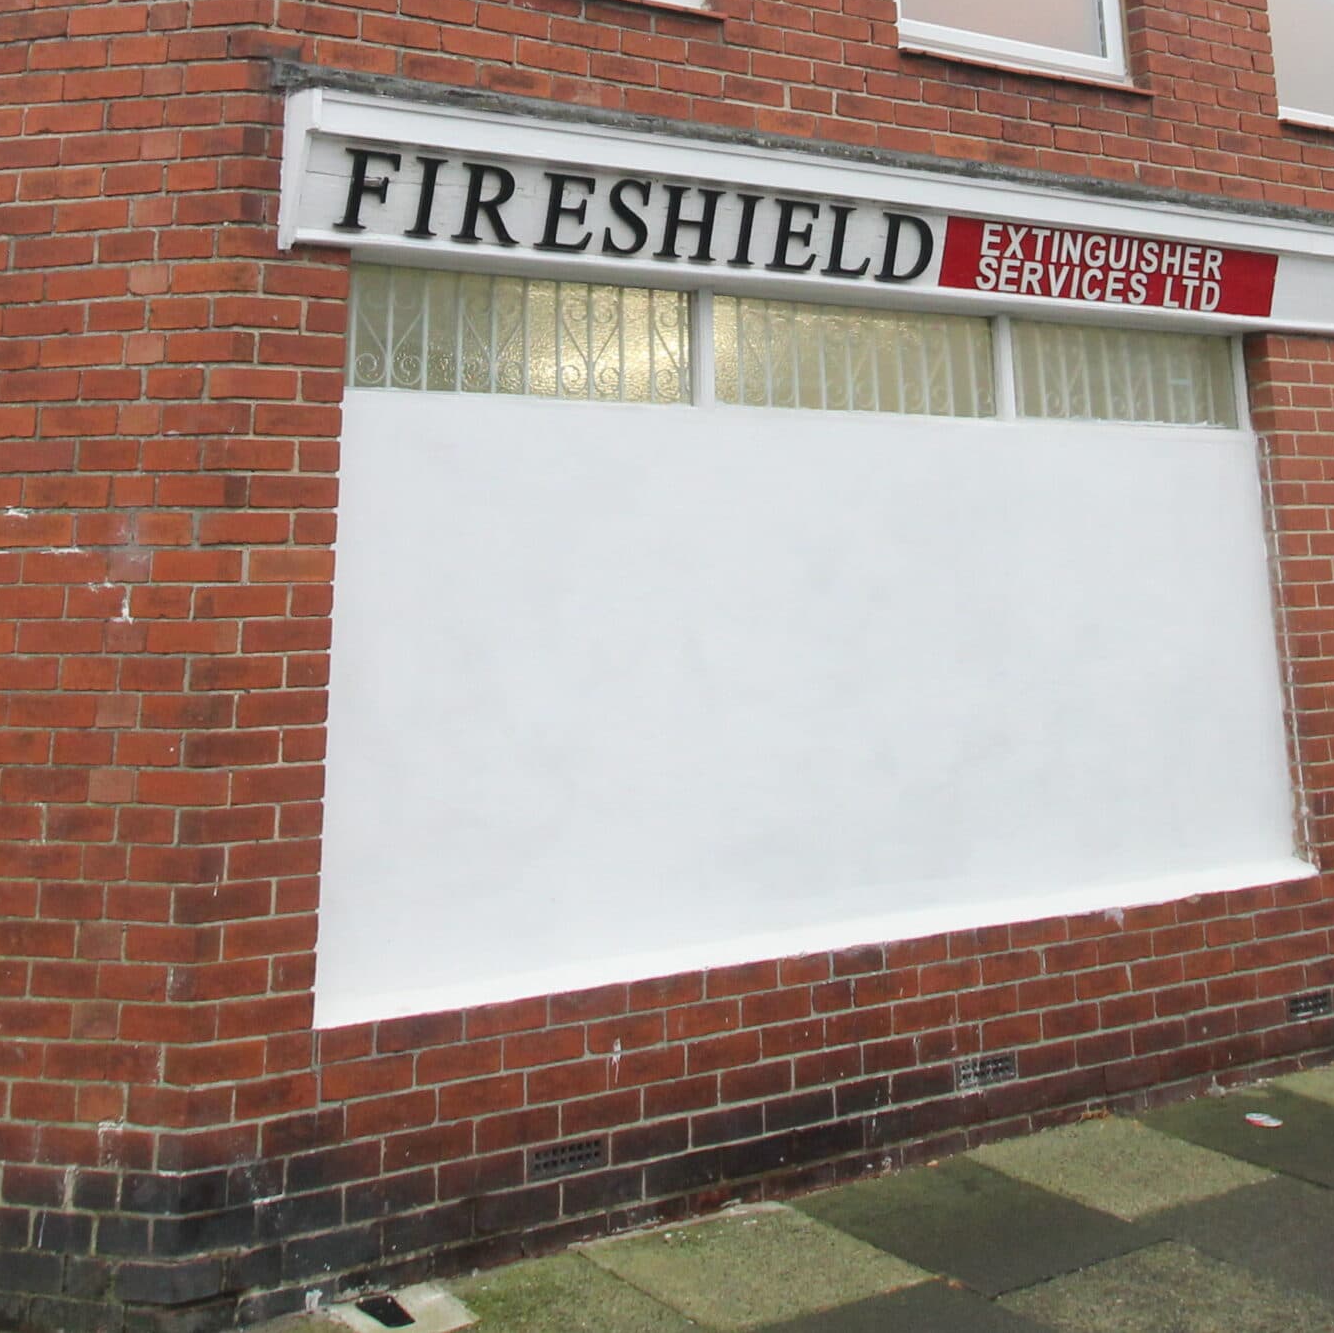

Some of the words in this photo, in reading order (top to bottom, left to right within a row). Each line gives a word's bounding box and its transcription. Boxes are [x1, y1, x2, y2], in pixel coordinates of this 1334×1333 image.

[334, 148, 934, 283] FIRESHIELD
[981, 223, 1223, 280] EXTINGUISHER
[976, 257, 1147, 304] SERVICES
[1163, 277, 1220, 311] LTD
